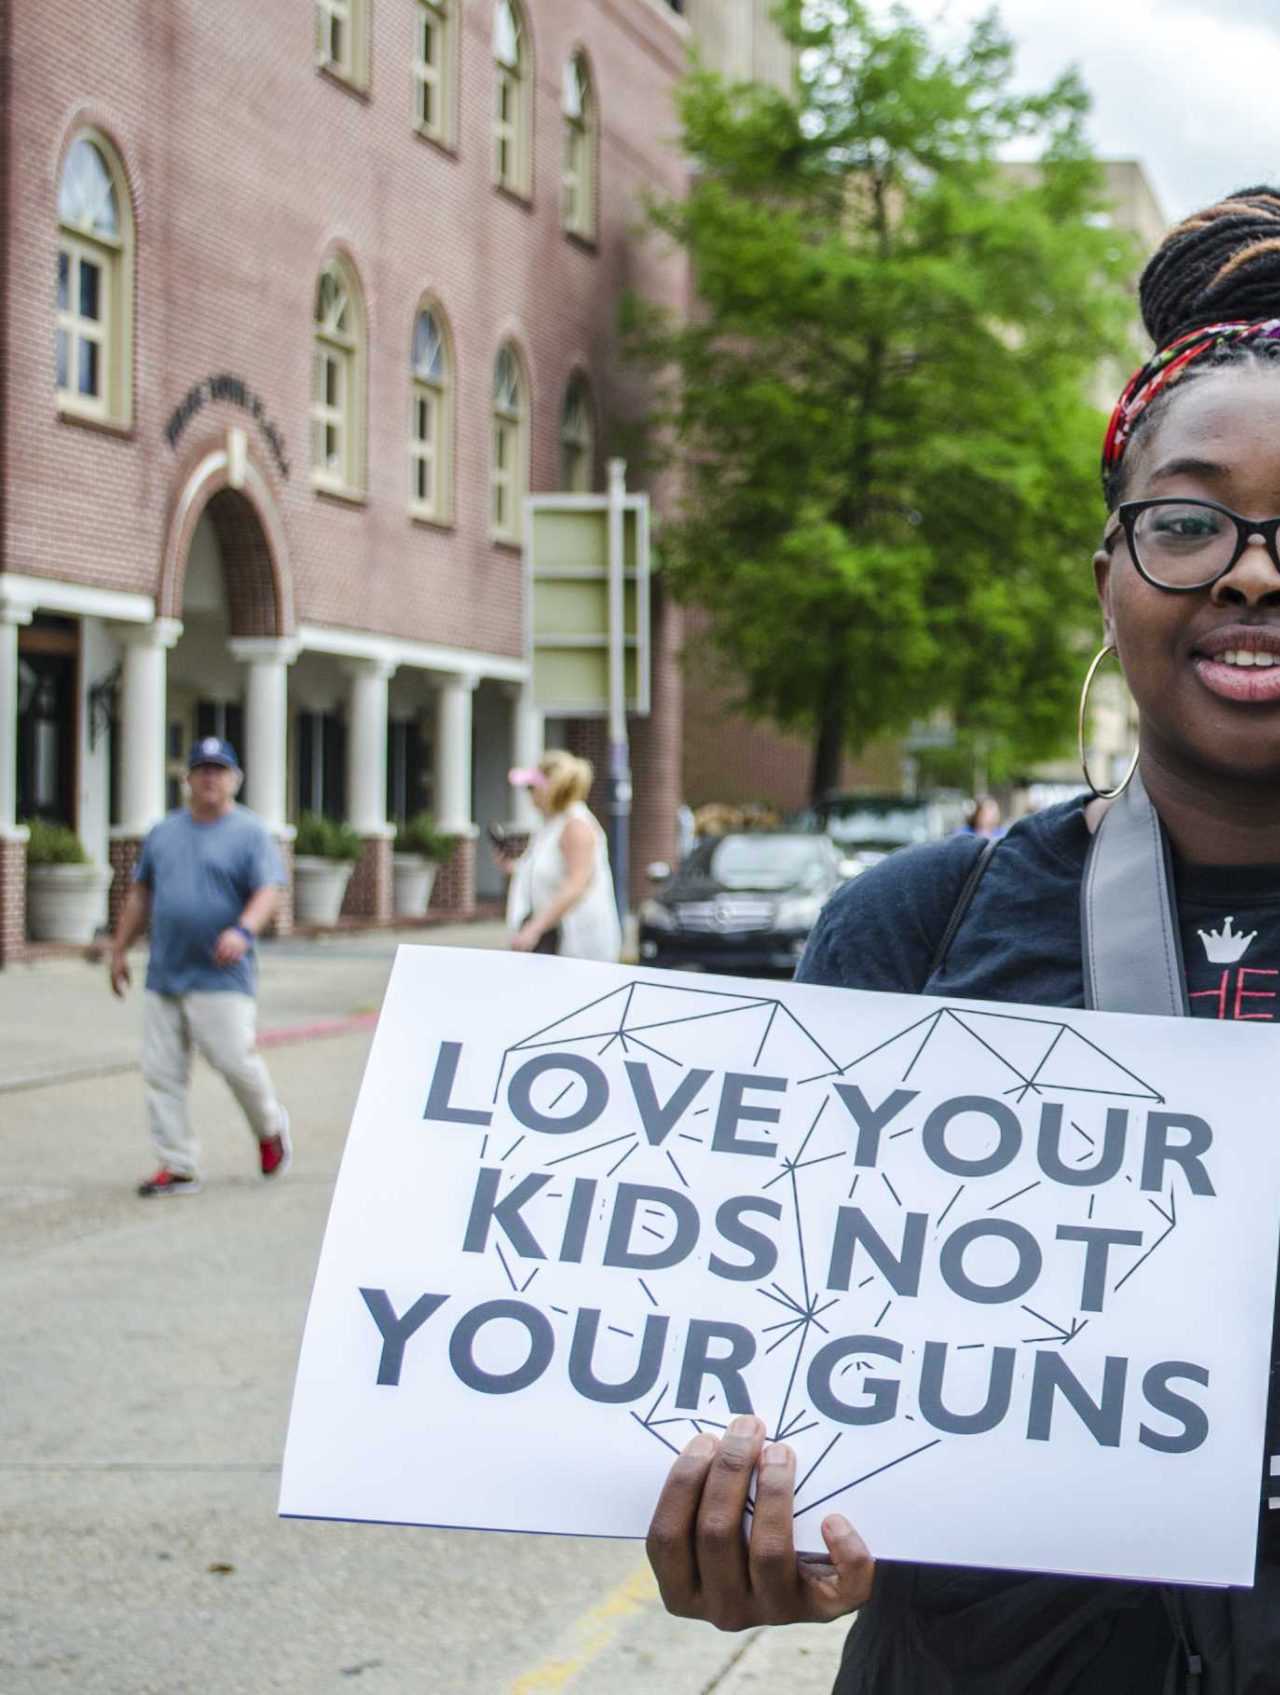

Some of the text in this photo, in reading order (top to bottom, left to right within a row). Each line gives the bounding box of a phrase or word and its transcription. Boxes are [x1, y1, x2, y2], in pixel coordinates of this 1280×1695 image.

[423, 1040, 1217, 1197] LOVE YOUR
[462, 1167, 1143, 1313] KIDS NOT
[359, 1288, 1210, 1454] YOUR GUNS
